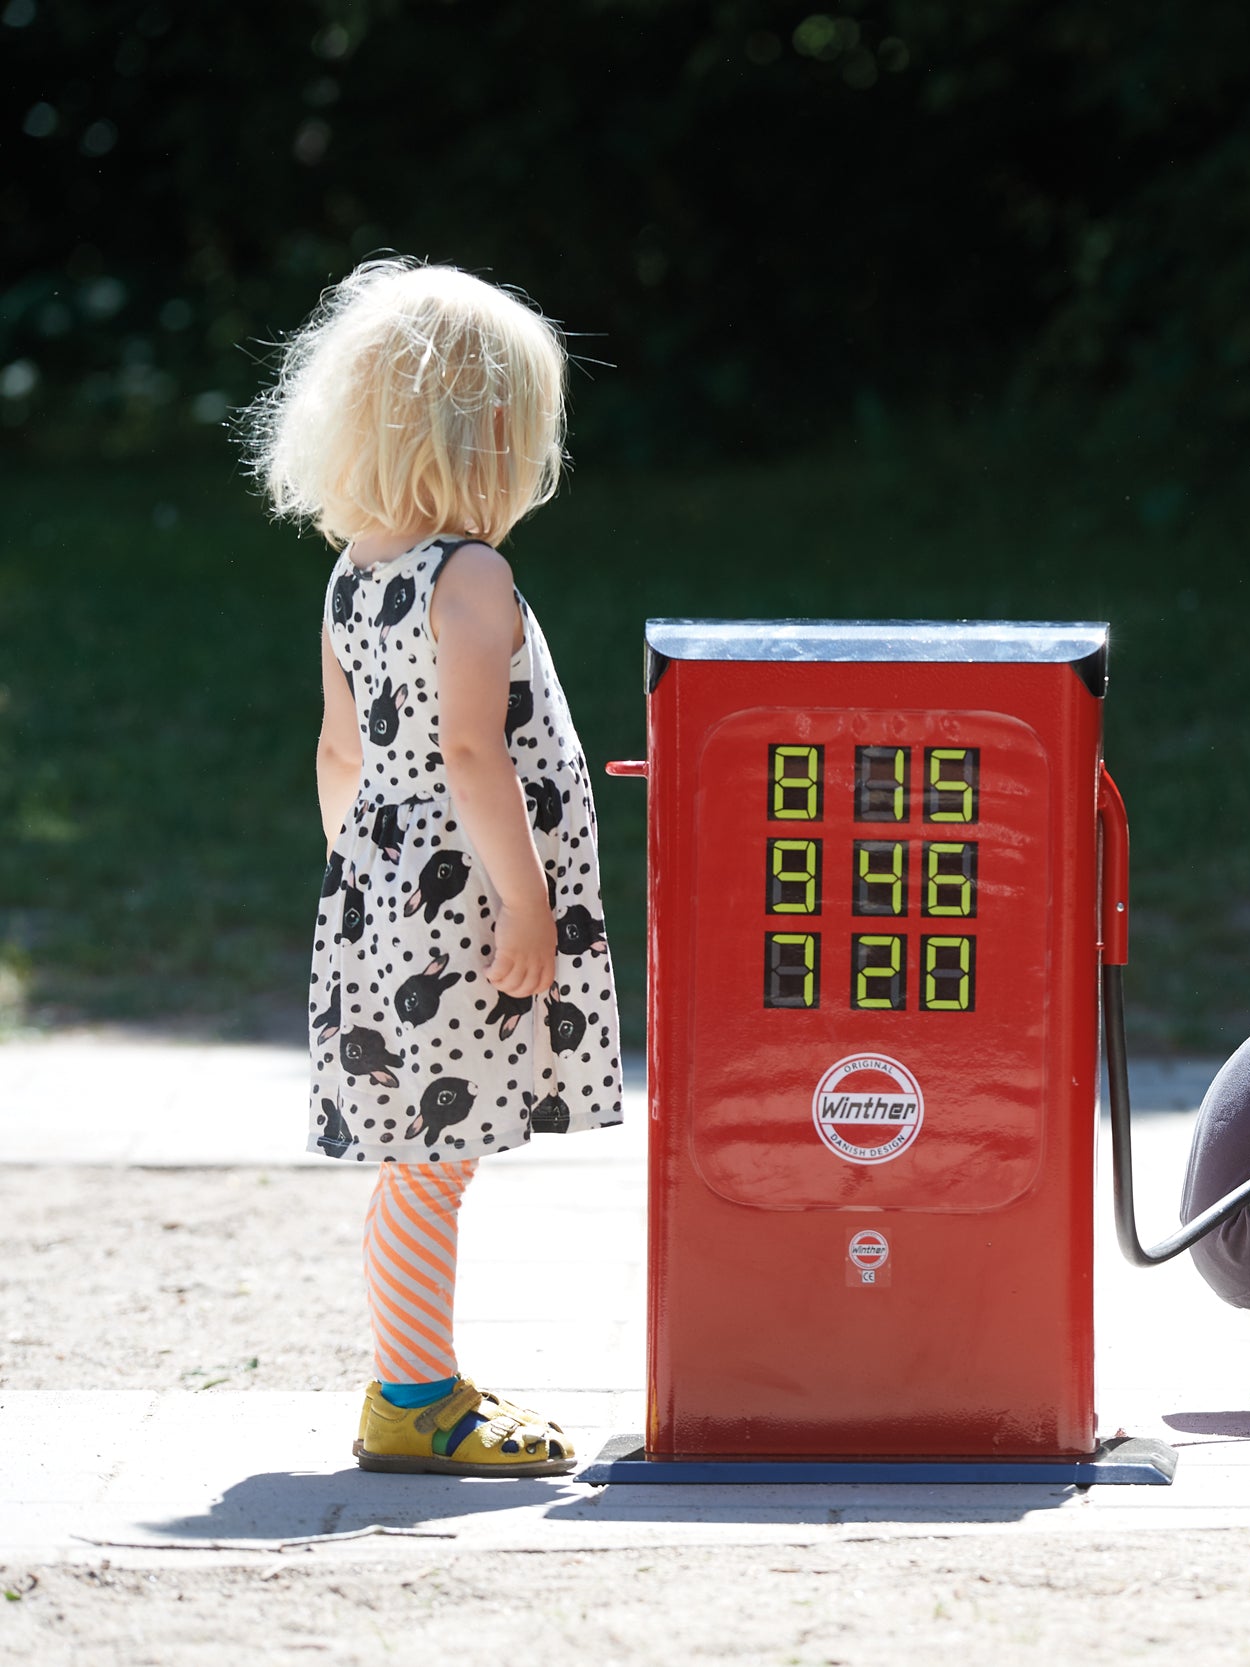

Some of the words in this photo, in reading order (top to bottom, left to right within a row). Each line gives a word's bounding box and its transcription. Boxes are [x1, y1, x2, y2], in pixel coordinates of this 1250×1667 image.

[773, 746, 818, 820] 8
[772, 839, 817, 914] 9
[771, 933, 815, 1008] 7
[843, 1060, 894, 1074] ORIGINAL
[821, 1096, 917, 1120] Winther
[830, 1133, 866, 1157] DANISH
[869, 1134, 906, 1157] DESIGN
